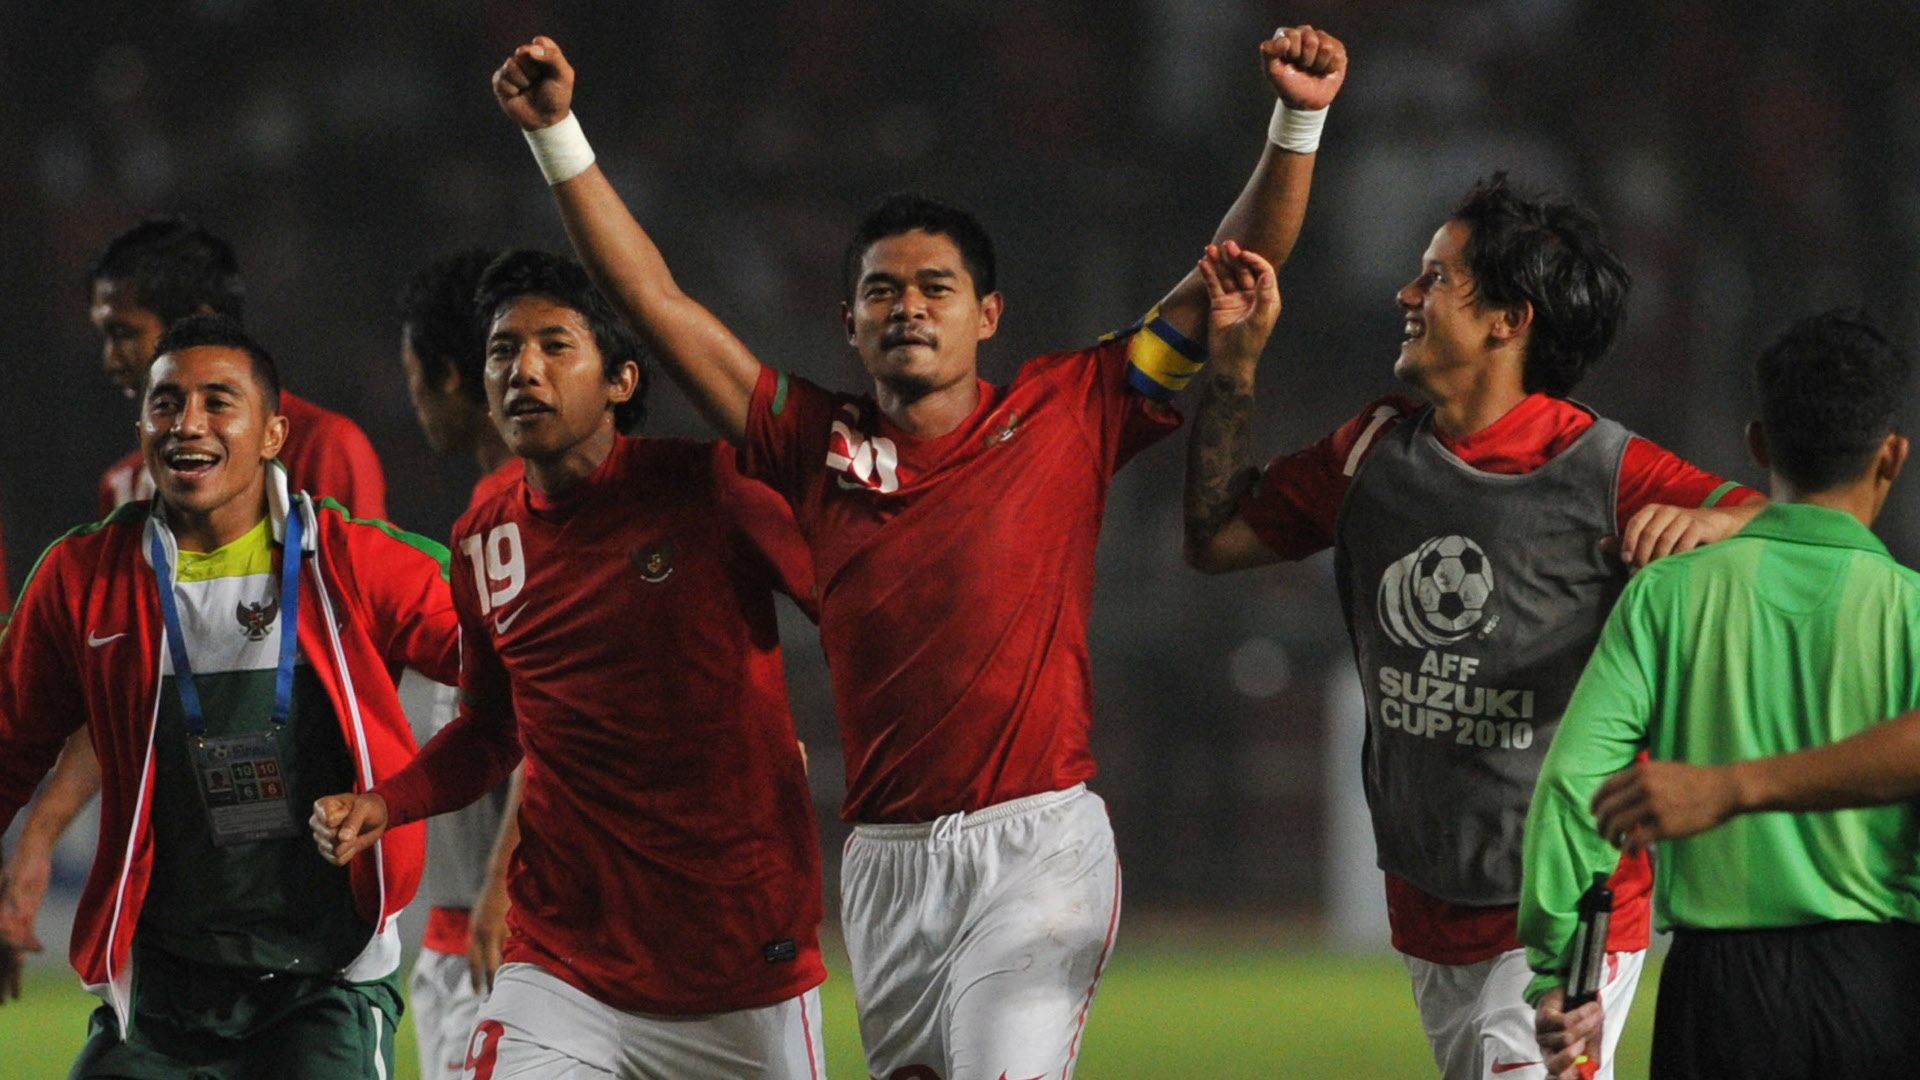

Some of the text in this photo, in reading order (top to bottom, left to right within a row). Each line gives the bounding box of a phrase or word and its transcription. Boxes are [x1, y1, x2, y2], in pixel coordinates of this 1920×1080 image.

[826, 404, 899, 493] 20
[459, 521, 525, 616] 19
[1379, 666, 1534, 718] SUZUKI
[1419, 650, 1480, 683] AFF
[1380, 698, 1533, 749] CUP 2010
[235, 763, 275, 778] 10 10
